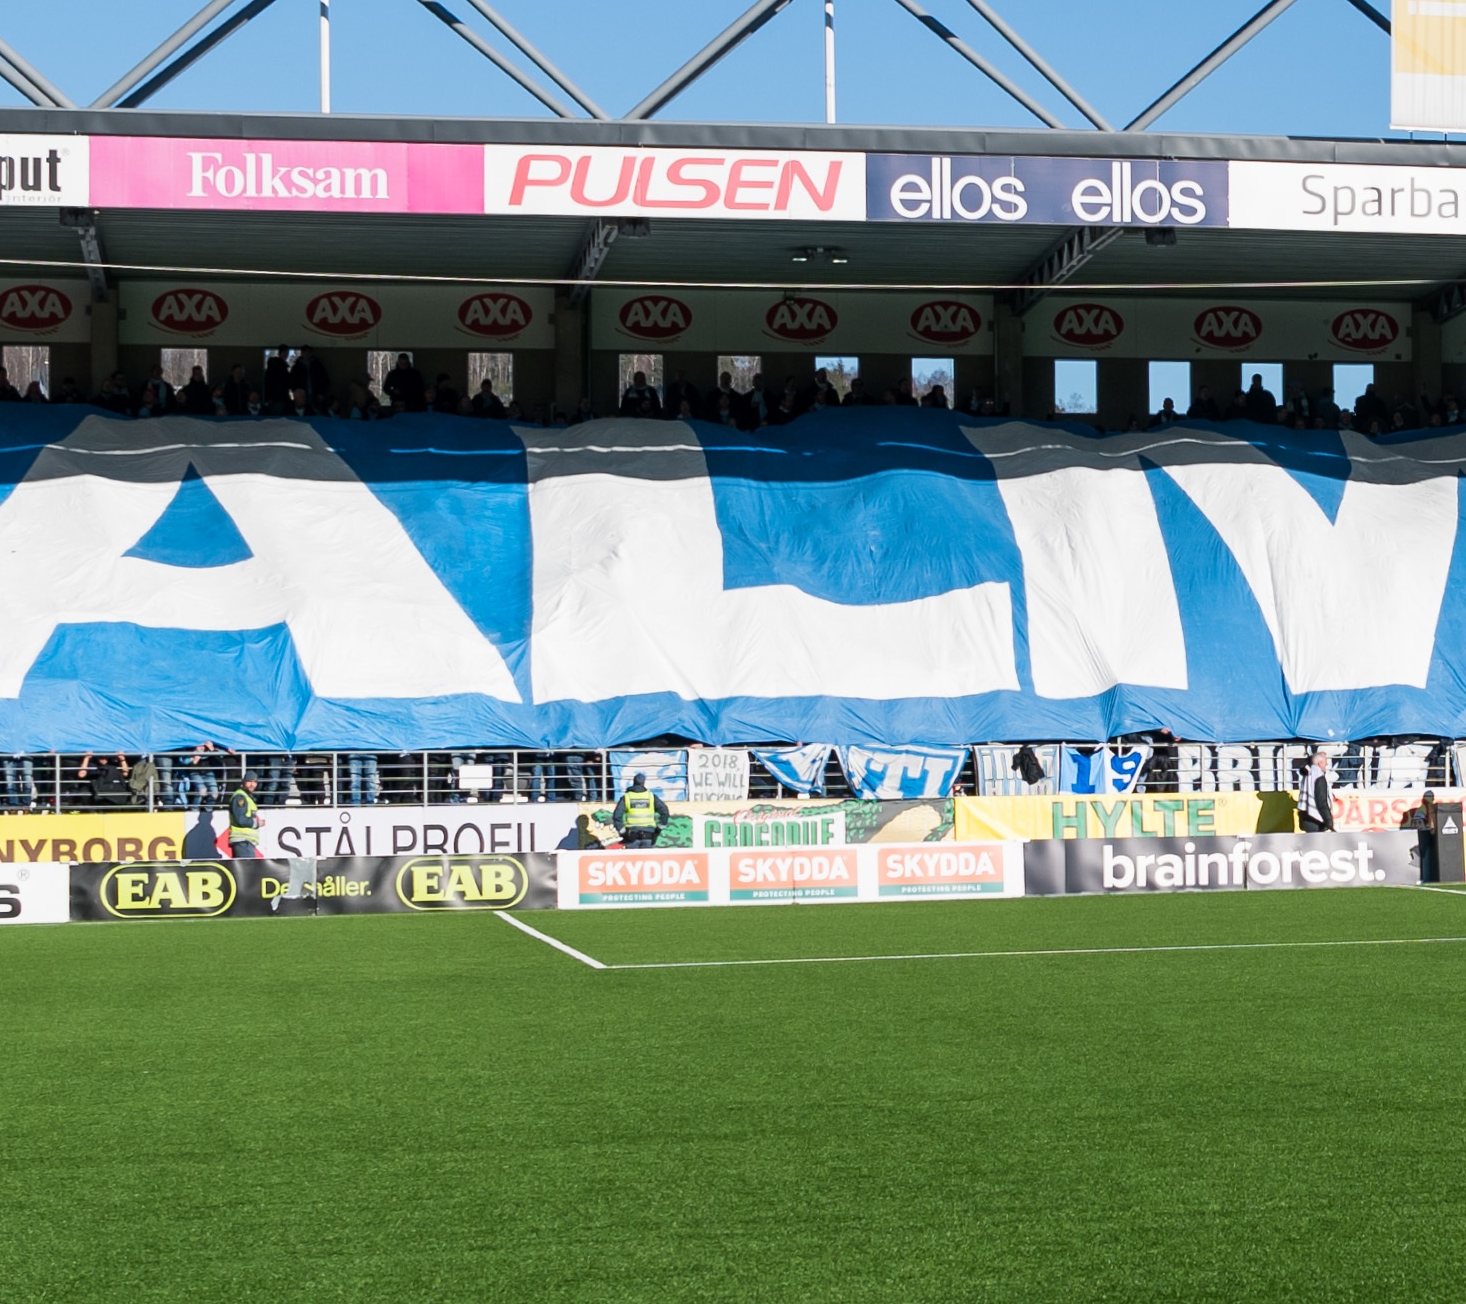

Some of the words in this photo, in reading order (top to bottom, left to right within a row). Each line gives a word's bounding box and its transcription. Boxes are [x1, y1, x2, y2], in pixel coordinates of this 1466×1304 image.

[186, 151, 390, 200] Folksam
[508, 153, 843, 212] PULSEN
[890, 157, 1028, 221] ellos
[1072, 160, 1206, 225] ellos
[0, 291, 66, 319] AXA
[917, 306, 975, 333] AXA
[692, 772, 713, 788] WE
[716, 772, 746, 788] WILL
[1053, 799, 1216, 839] HYLTE
[588, 855, 701, 887] SKYDDA
[738, 852, 849, 883] SKYDDA
[886, 848, 996, 879] SKYDDA
[1102, 841, 1386, 890] brainforest.
[116, 869, 222, 911] EAB
[411, 862, 515, 904] EAB
[602, 893, 653, 902] PROTECTING
[655, 892, 685, 900] PEOPLE
[753, 890, 804, 898] PROTECTING
[806, 888, 835, 897] PEOPLE
[902, 886, 952, 894] PROTECTING
[955, 884, 981, 893] PEOPLE
